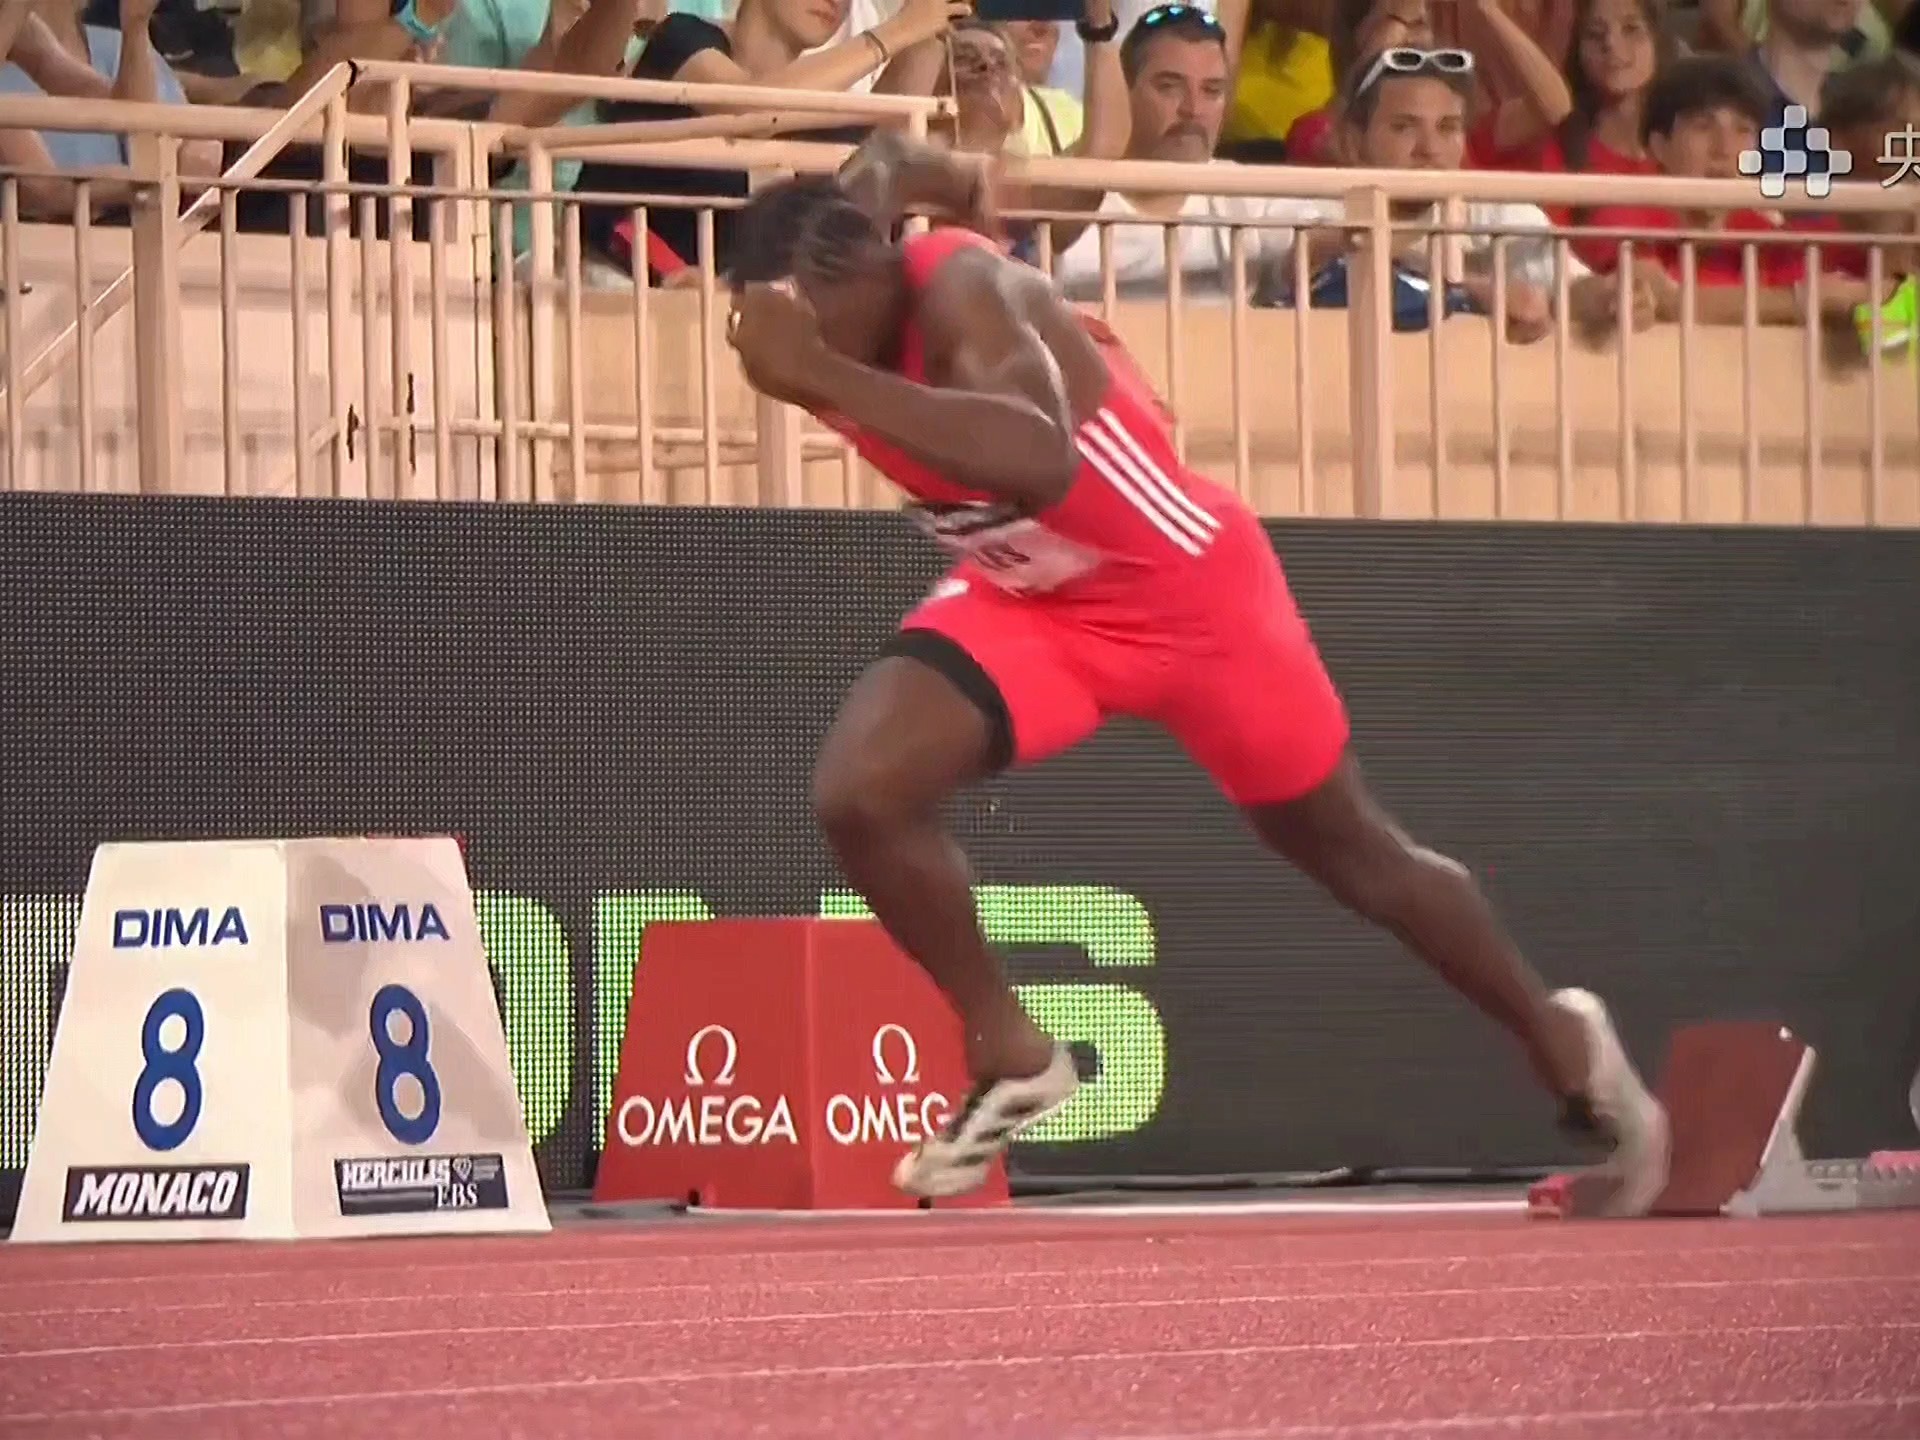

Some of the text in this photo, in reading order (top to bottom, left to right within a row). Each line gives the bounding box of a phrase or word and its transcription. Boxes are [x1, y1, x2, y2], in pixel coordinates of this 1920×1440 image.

[113, 906, 249, 948] DIMA
[320, 903, 450, 943] DIMA
[132, 986, 205, 1151] 8
[370, 983, 441, 1146] 8
[617, 1094, 799, 1146] OMEGA
[826, 1092, 953, 1145] OMEG
[72, 1170, 239, 1216] MONACO
